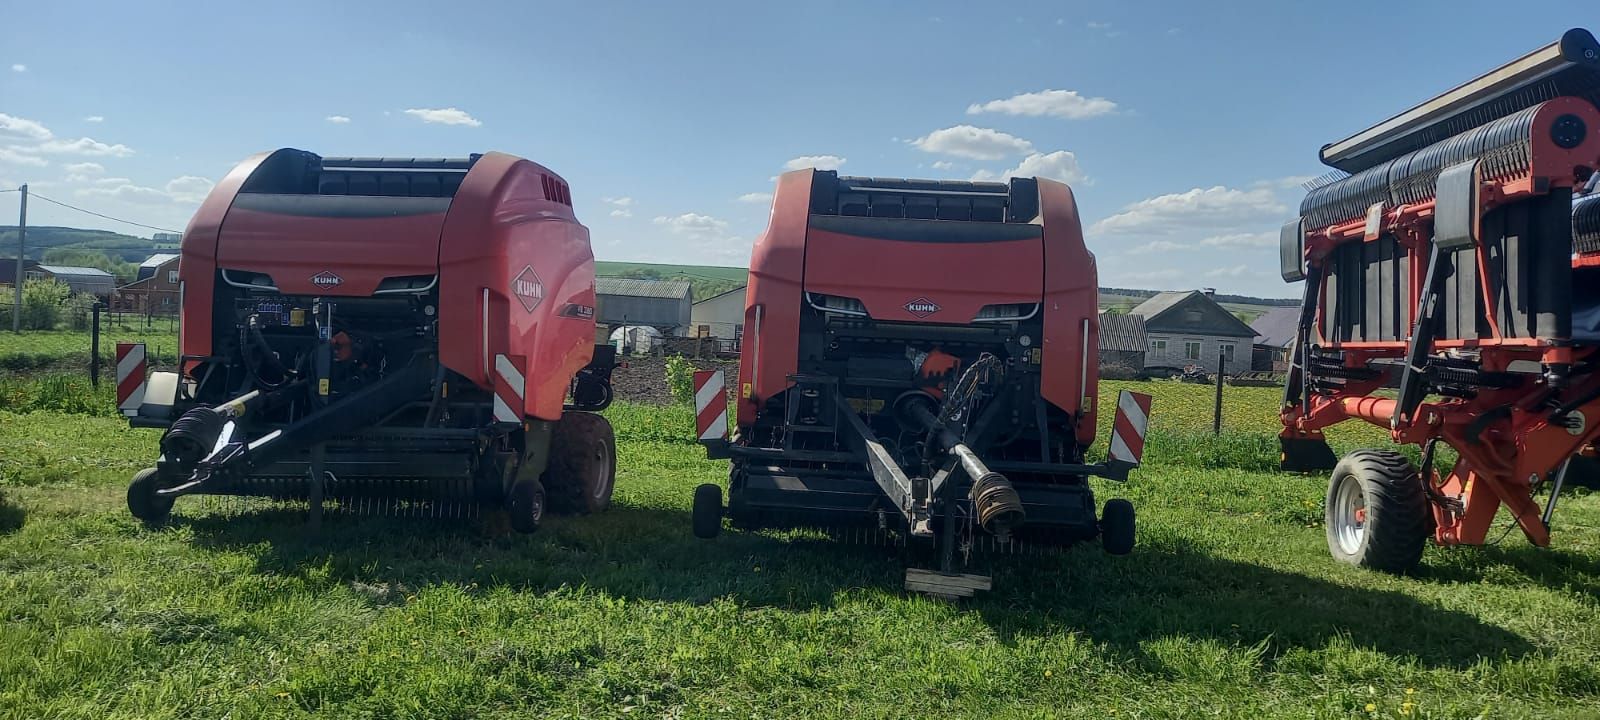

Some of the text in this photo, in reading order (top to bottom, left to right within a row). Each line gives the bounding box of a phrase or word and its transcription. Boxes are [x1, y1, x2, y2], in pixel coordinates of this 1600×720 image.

[314, 276, 338, 284] KUHN
[517, 279, 543, 298] KUHN
[909, 304, 935, 312] KUHN
